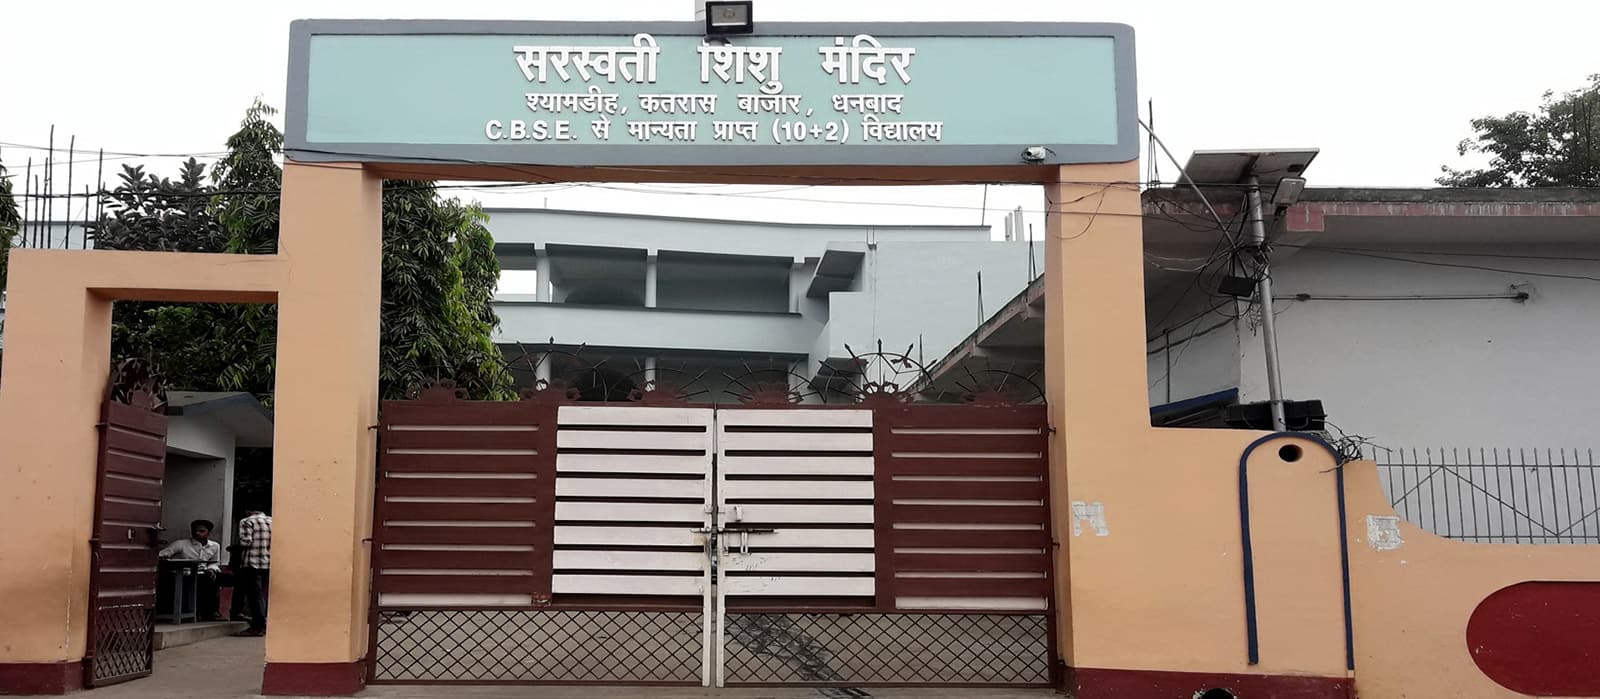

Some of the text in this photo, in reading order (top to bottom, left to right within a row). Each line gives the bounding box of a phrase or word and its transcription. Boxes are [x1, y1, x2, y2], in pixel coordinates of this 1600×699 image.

[513, 33, 916, 94] सरस्वती शिशु मंदिर
[638, 93, 718, 113] कतरास
[832, 93, 905, 114] धनबाद
[485, 113, 944, 144] C.B.S.E. से मान्यता प्राप्त (10+2) विद्यालय
